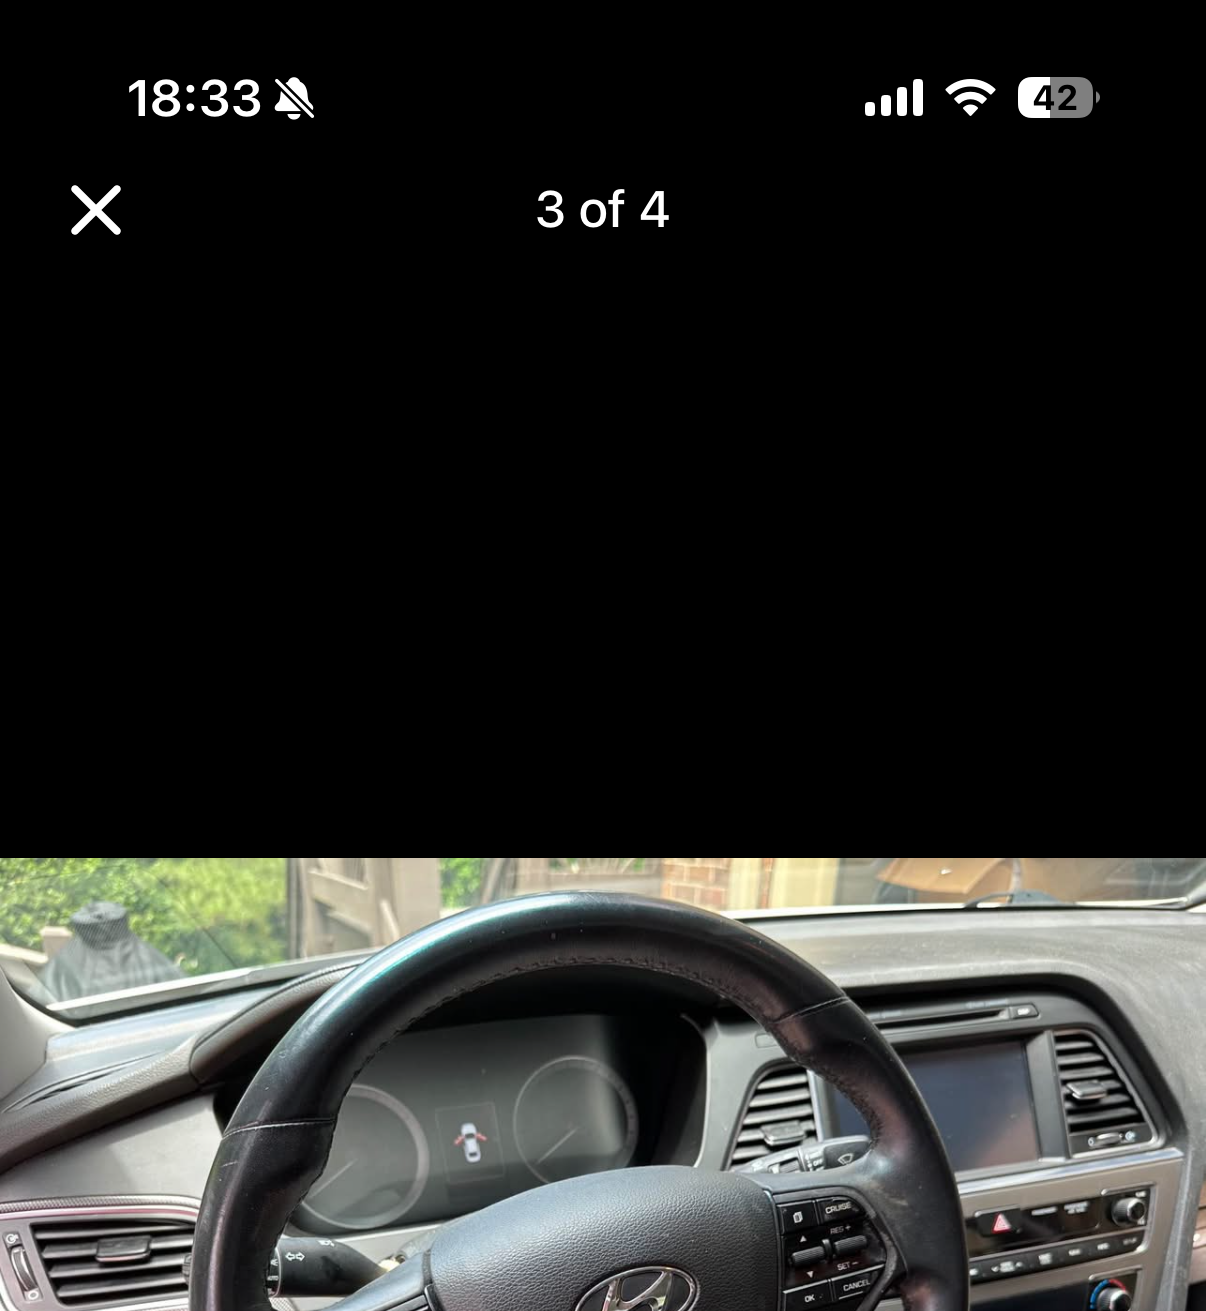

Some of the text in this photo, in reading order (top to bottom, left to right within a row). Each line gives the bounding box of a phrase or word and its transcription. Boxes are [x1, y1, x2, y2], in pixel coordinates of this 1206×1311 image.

[825, 1201, 851, 1214] CRUISE
[837, 1261, 851, 1271] SET
[843, 1279, 870, 1292] CANCEL
[804, 1294, 816, 1303] OK
